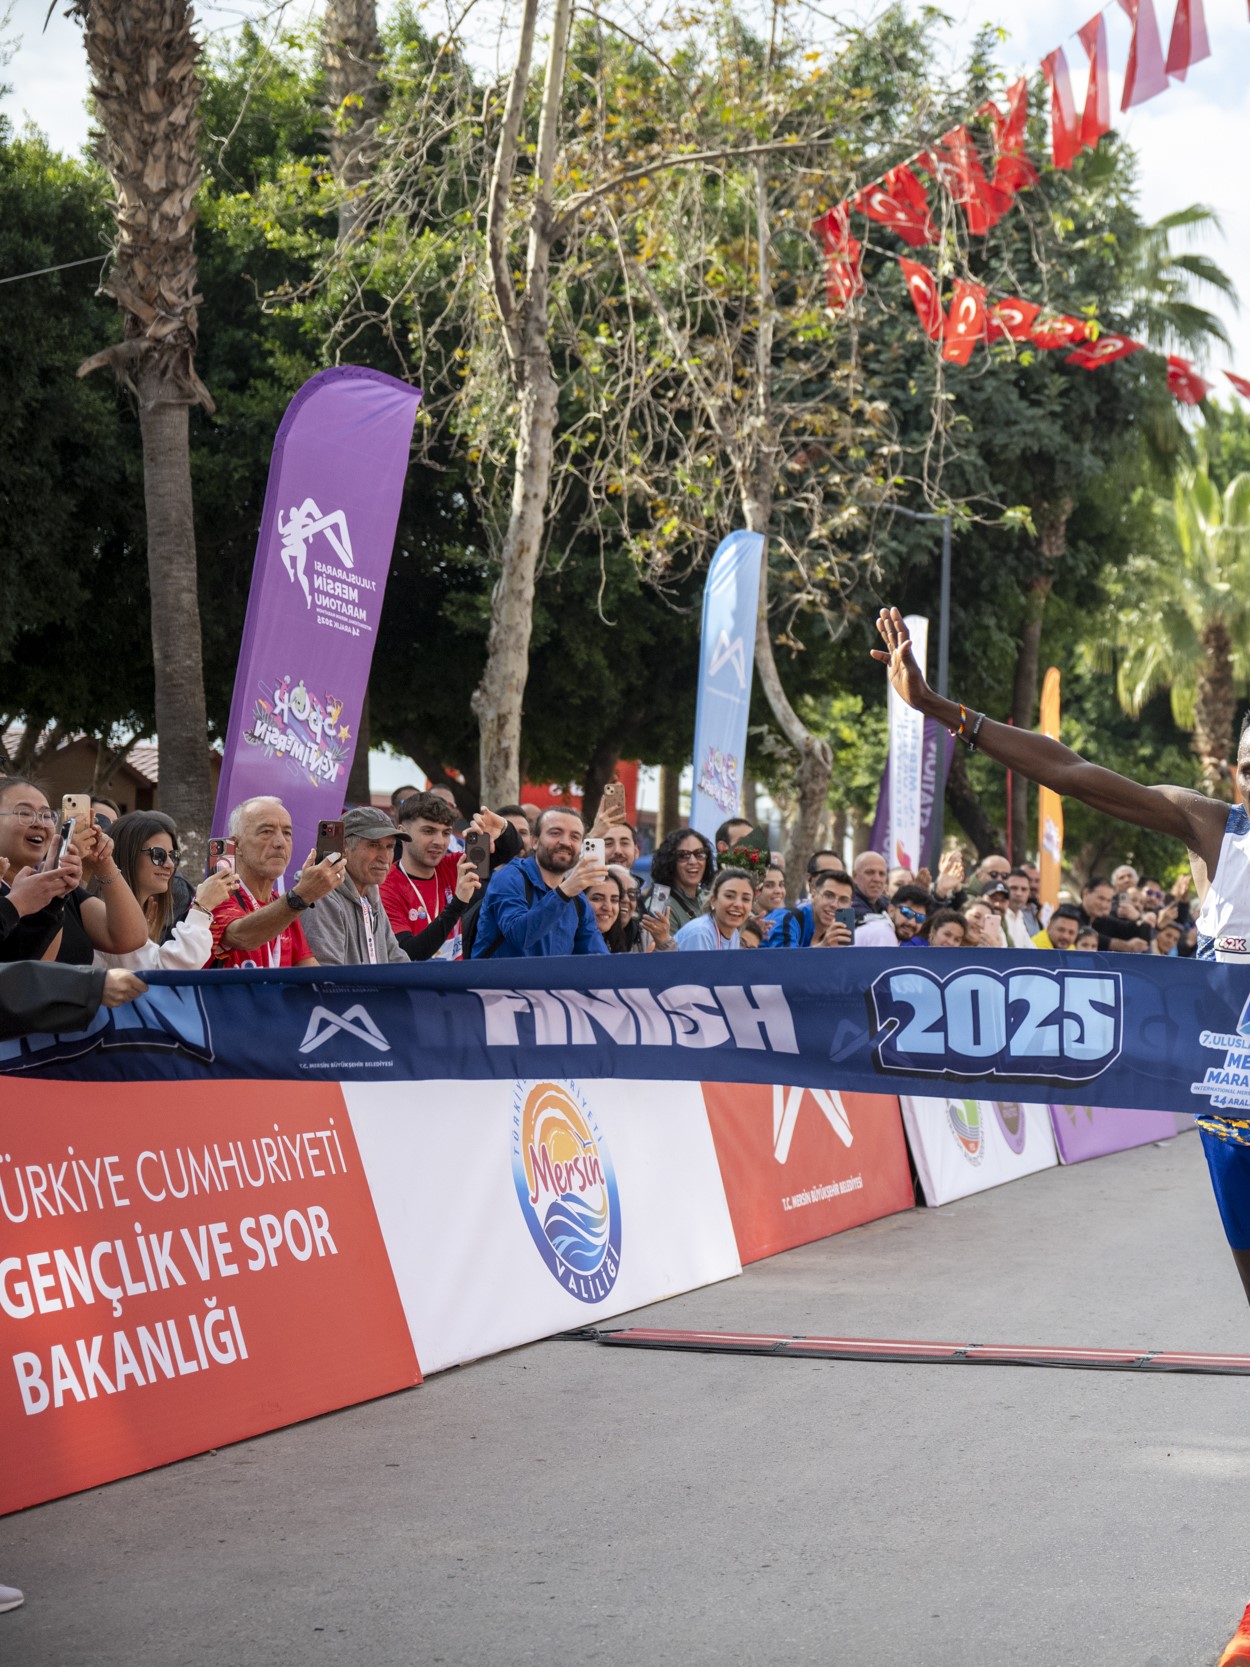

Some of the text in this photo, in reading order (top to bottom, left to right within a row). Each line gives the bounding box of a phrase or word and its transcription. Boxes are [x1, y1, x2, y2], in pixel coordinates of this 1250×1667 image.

[467, 984, 800, 1054] FINISH
[889, 973, 1115, 1061] 2025
[1213, 1095, 1227, 1105] 14
[136, 1117, 348, 1202] CUMHURİYETİ
[0, 1205, 339, 1320] GENÇLİK VE SPOR
[555, 1244, 620, 1300] VALİLİĞİ
[12, 1296, 249, 1416] BAKANLIĞI
